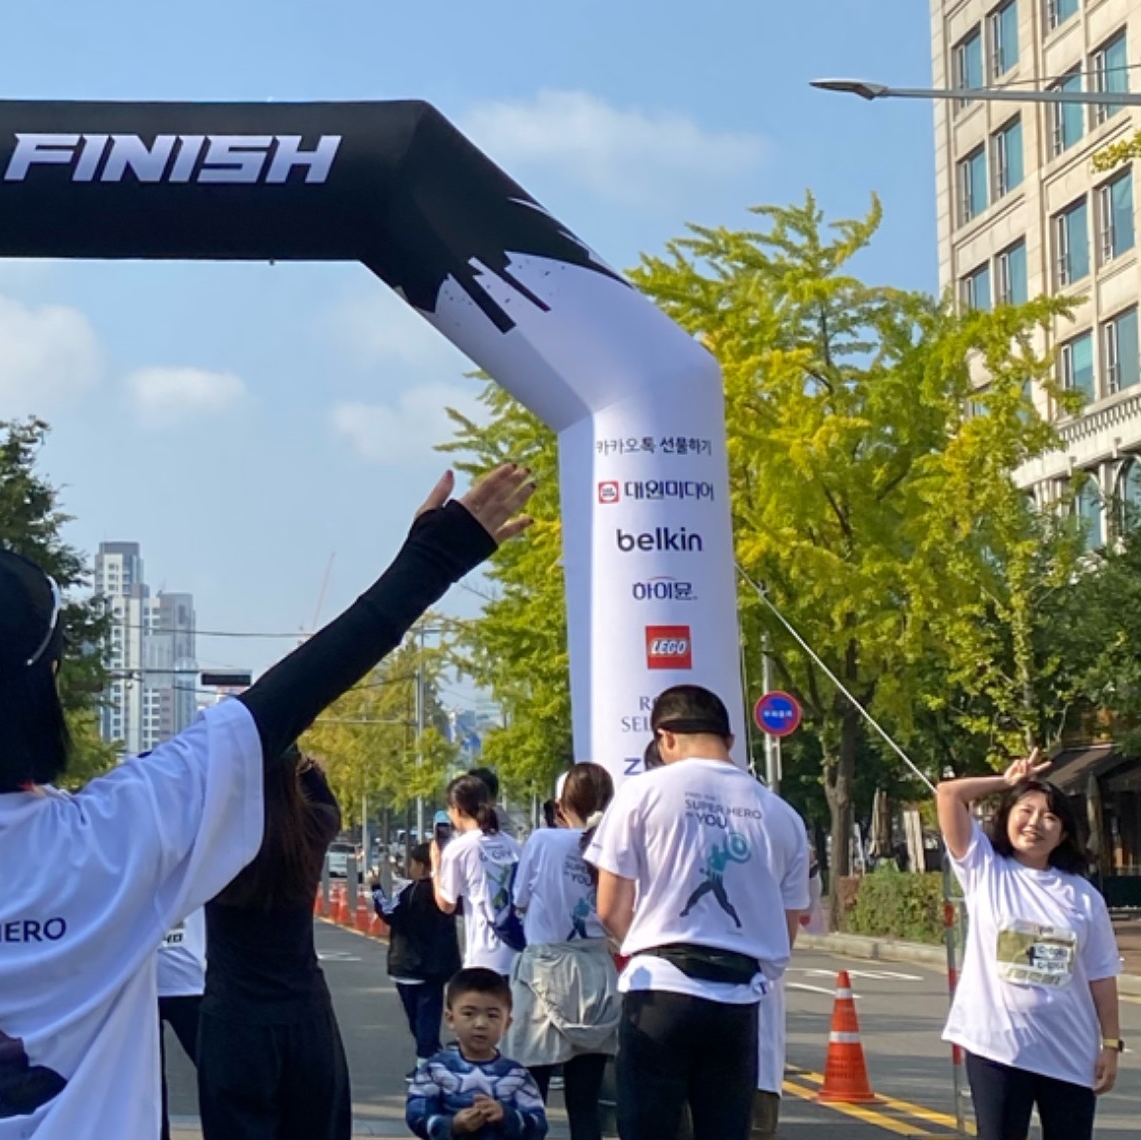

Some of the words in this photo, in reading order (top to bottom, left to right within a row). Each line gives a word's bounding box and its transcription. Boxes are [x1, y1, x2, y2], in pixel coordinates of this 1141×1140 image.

[3, 133, 342, 184] FINISH
[660, 436, 712, 456] 선물하기
[624, 480, 714, 501] 대원미디어
[616, 527, 703, 551] belkin
[632, 582, 692, 600] 하이뮨
[651, 640, 686, 655] LEGO
[696, 812, 727, 829] YOU
